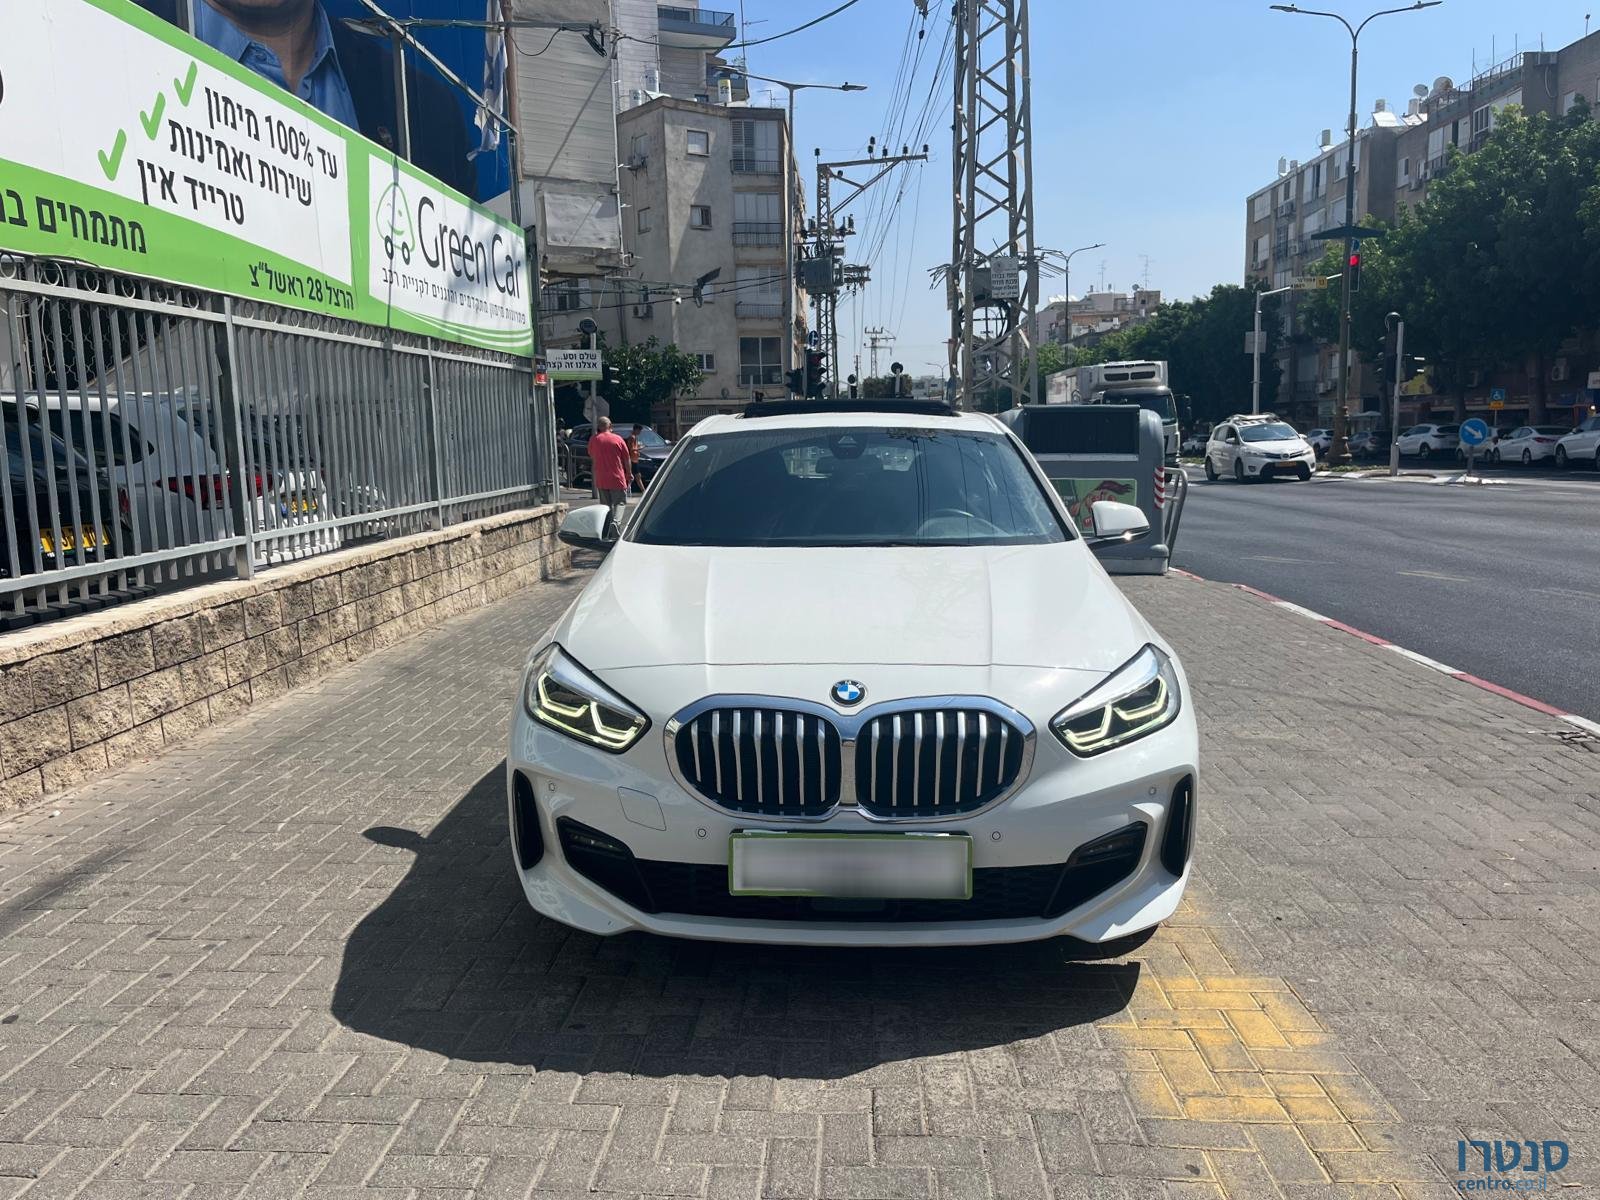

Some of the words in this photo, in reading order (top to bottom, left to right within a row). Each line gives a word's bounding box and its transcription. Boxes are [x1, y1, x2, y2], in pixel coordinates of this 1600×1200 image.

[204, 86, 261, 142] מימון
[168, 118, 254, 183] ואמינות
[265, 115, 314, 168] 100%
[136, 158, 178, 205] אין
[257, 159, 312, 206] שירות
[316, 146, 338, 179] עד
[183, 175, 245, 225] טרייד
[35, 195, 147, 254] מתמחים
[417, 196, 489, 288] Green
[491, 233, 521, 299] Car
[306, 276, 323, 303] 28
[324, 280, 354, 310] הרצל
[382, 267, 400, 287] רכב
[402, 273, 429, 299] לקניית
[565, 361, 573, 369] זה
[575, 360, 598, 369] אצלנו
[579, 352, 597, 360] שלם
